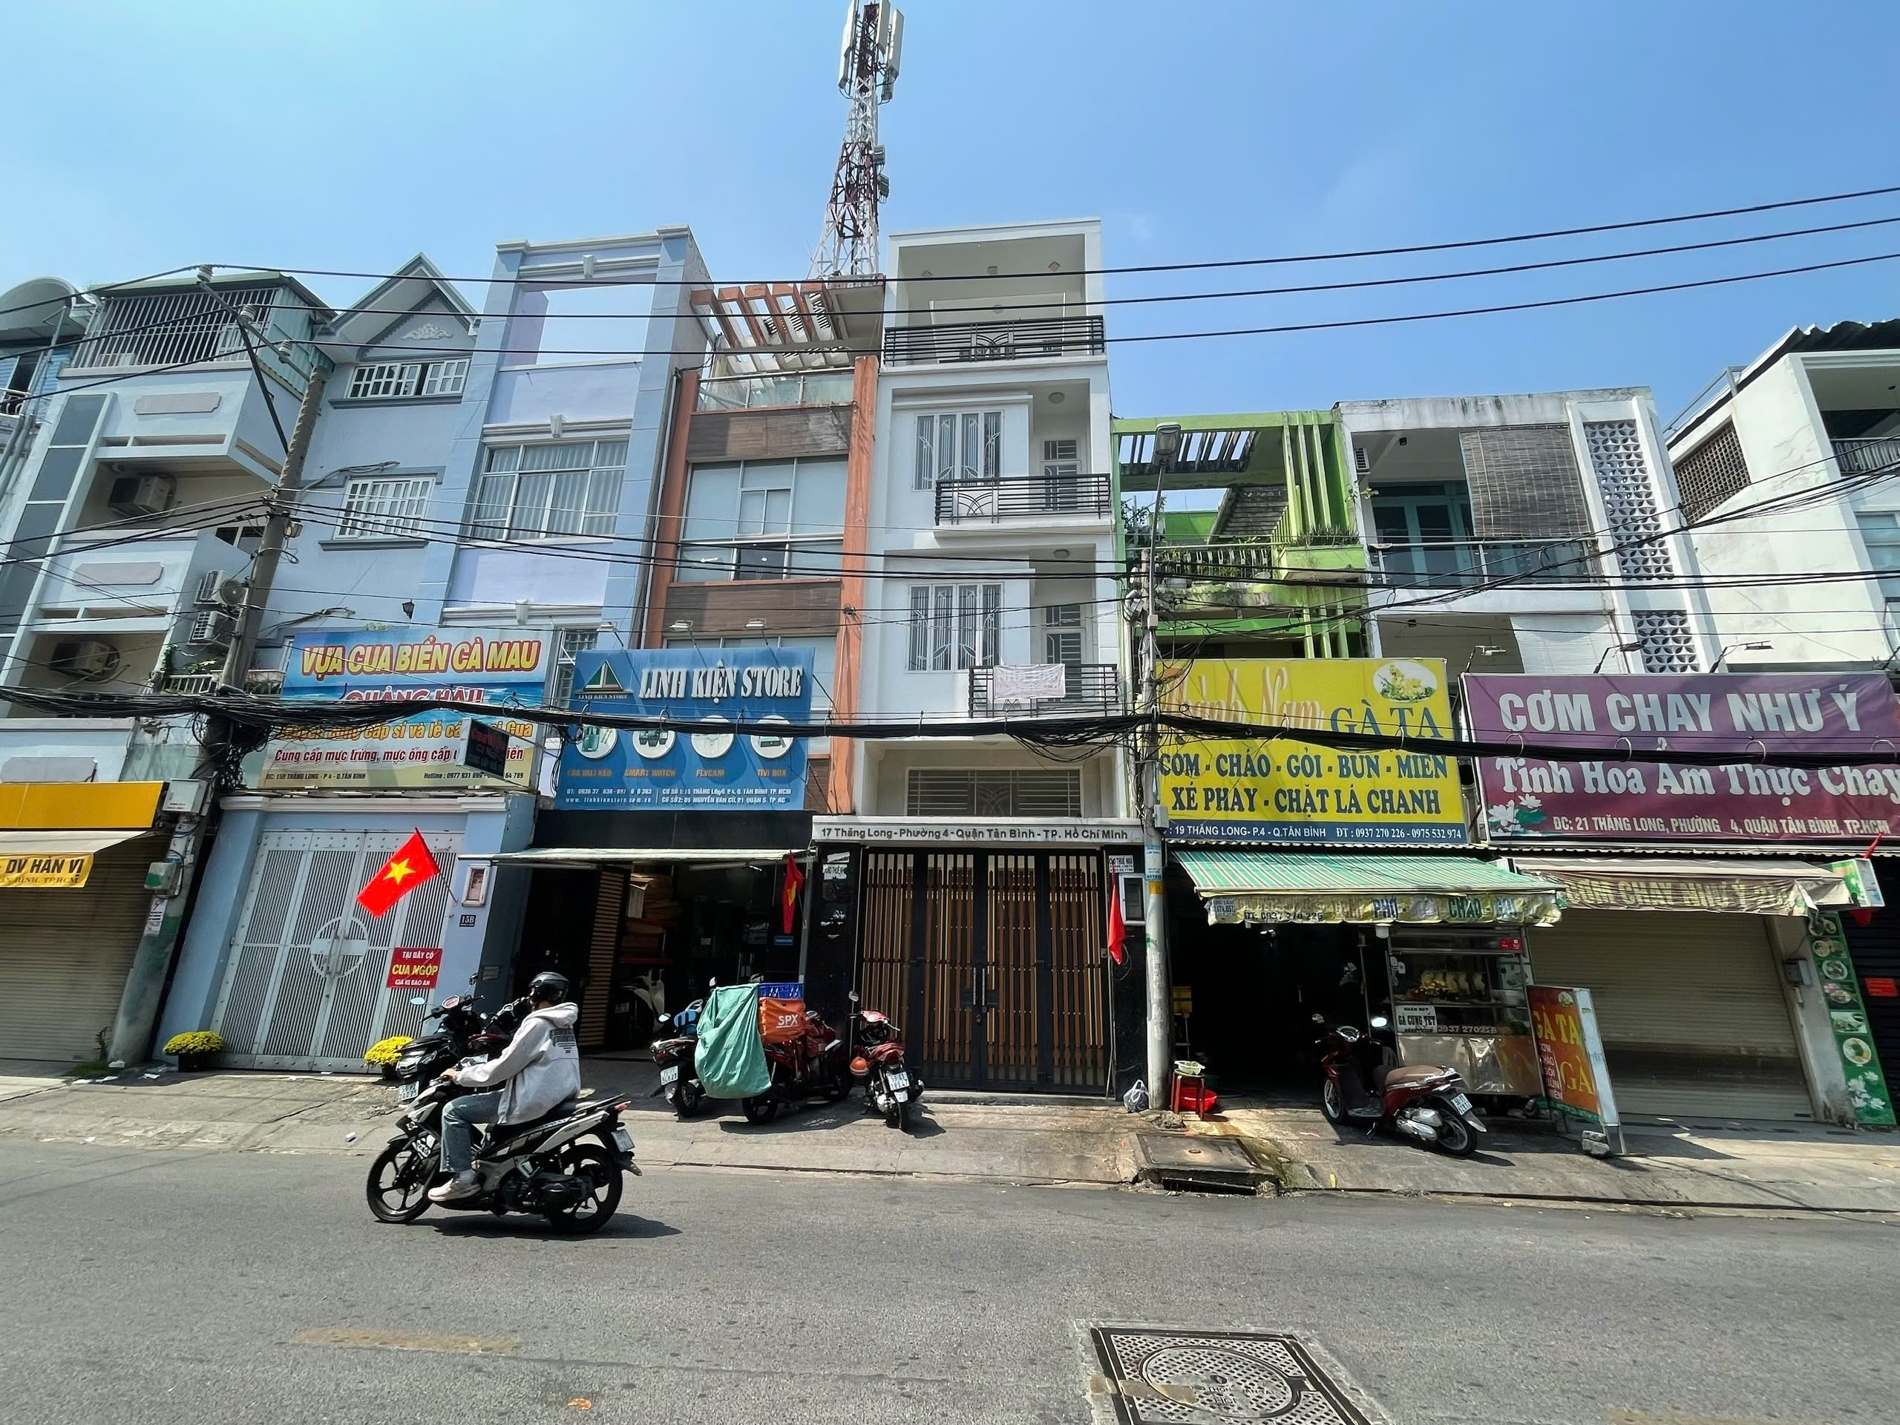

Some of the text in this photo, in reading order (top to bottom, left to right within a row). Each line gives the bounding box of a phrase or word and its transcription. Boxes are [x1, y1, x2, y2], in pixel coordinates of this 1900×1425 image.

[302, 635, 542, 680] VỰA CUA BIỂN CÀ MAU
[639, 659, 804, 704] LINH KIỆN STORE
[1330, 699, 1444, 739] GÀ TA
[1499, 683, 1861, 732] CƠM CHAY NHƯ Ý
[409, 721, 425, 739] và
[506, 720, 533, 738] Cua
[275, 749, 301, 765] Cung
[325, 749, 348, 765] mực
[382, 748, 406, 765] mực
[431, 745, 451, 763] cấp
[1216, 748, 1271, 778] CHÁO
[1286, 747, 1323, 778] GỎI
[1495, 757, 1575, 794] Tinh
[1579, 761, 1646, 794] Hoa
[1719, 764, 1811, 807] Thực
[1817, 765, 1900, 805] Chay
[1171, 781, 1442, 818] XÉ PHAY CHẶT LÁ CHANH
[822, 828, 832, 837] 17
[834, 828, 866, 839] Thăng
[899, 827, 941, 839] Phường
[987, 829, 1006, 838] Tân
[1009, 829, 1035, 838] Bình
[1064, 826, 1079, 839] Hồ
[1081, 829, 1099, 839] Chí
[1175, 826, 1185, 835] 19
[1187, 823, 1219, 835] THĂNG
[1273, 825, 1302, 837] Q.TÂN
[1304, 826, 1326, 837] BÌNH
[1356, 827, 1373, 838] 0937
[1376, 828, 1390, 838] 270
[1391, 828, 1405, 838] 226
[1411, 829, 1431, 838] 0975
[1431, 829, 1446, 838] 532
[1447, 829, 1462, 839] 974
[1553, 816, 1573, 830] ĐC:
[1575, 817, 1590, 831] 21
[1591, 814, 1631, 831] THĂNG
[1633, 817, 1669, 834] LONG,
[1670, 815, 1722, 833] PHƯỜNG
[1730, 821, 1743, 834] 4,
[1744, 816, 1776, 837] QUẬN
[1778, 816, 1807, 834] TÂN
[6, 859, 28, 873] DV
[1617, 879, 1673, 905] CHAY
[461, 915, 475, 924] 15B
[402, 951, 412, 960] TẠI
[391, 964, 410, 975] CUA
[778, 1014, 799, 1027] SPX
[1555, 1013, 1581, 1045] TA
[1560, 1055, 1595, 1095] GÀ
